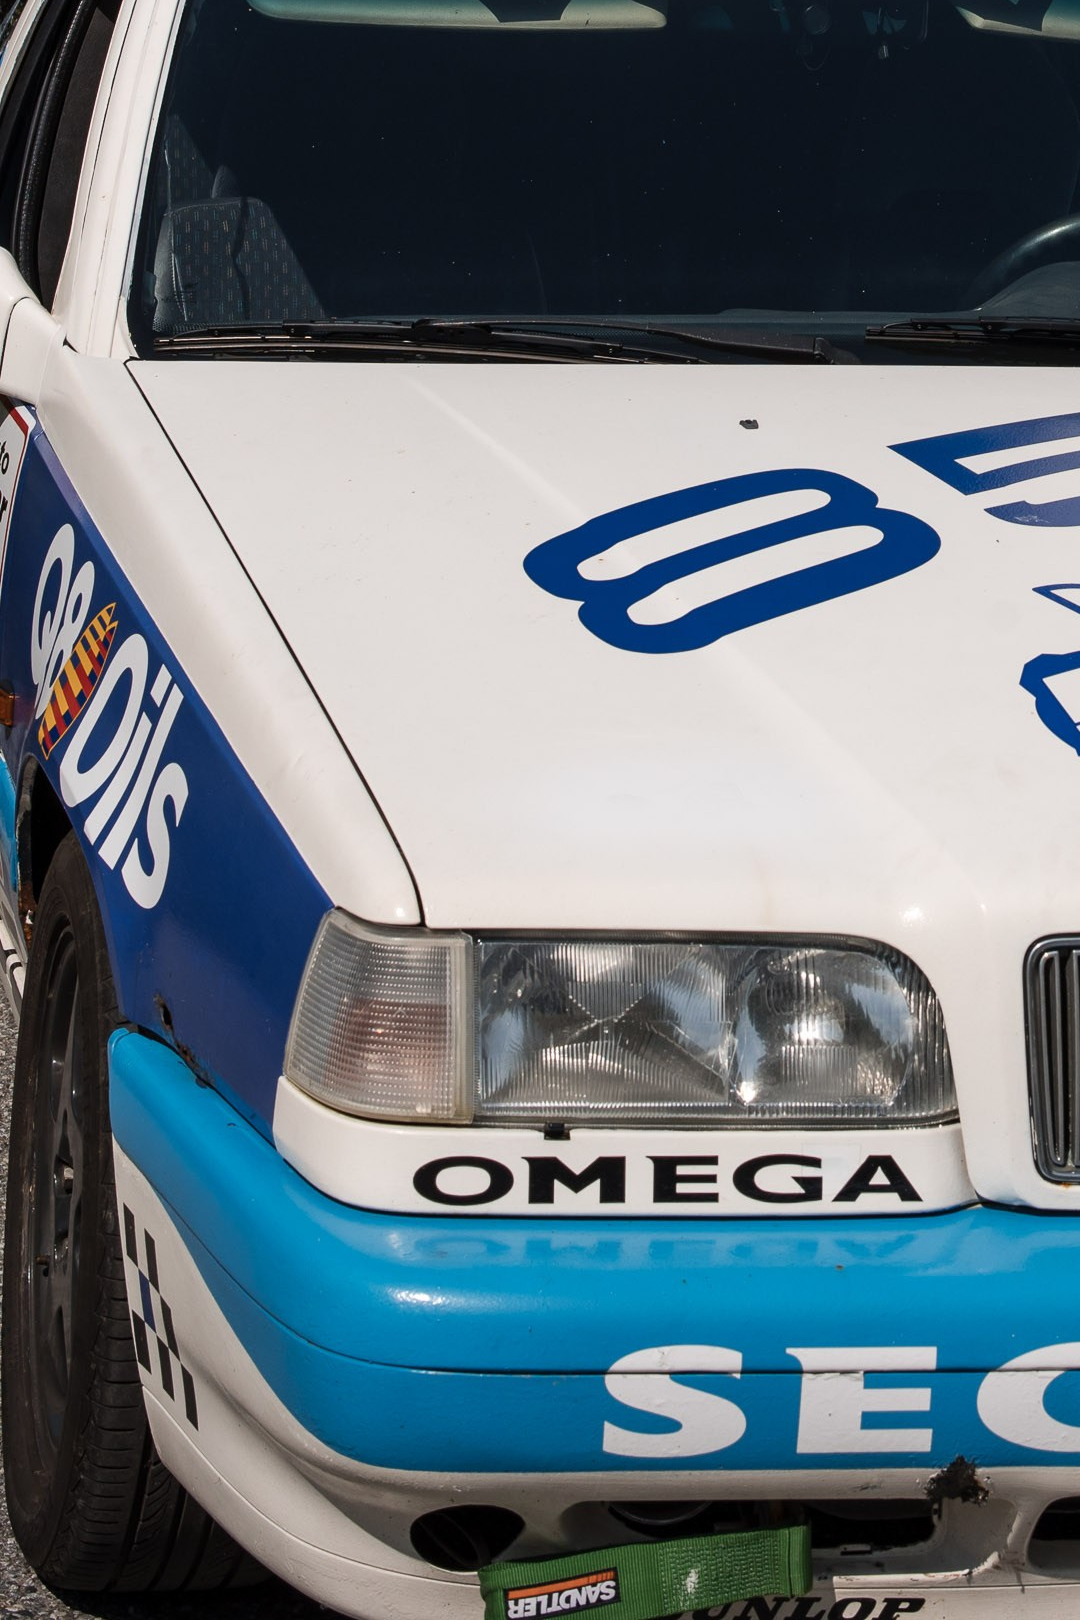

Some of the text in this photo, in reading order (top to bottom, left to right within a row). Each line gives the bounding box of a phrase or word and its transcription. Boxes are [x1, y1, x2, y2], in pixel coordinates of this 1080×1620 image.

[60, 633, 189, 909] Oils
[413, 1155, 923, 1206] OMEGA
[507, 1580, 617, 1619] SANDTLER
[650, 1596, 927, 1620] UNLOP
